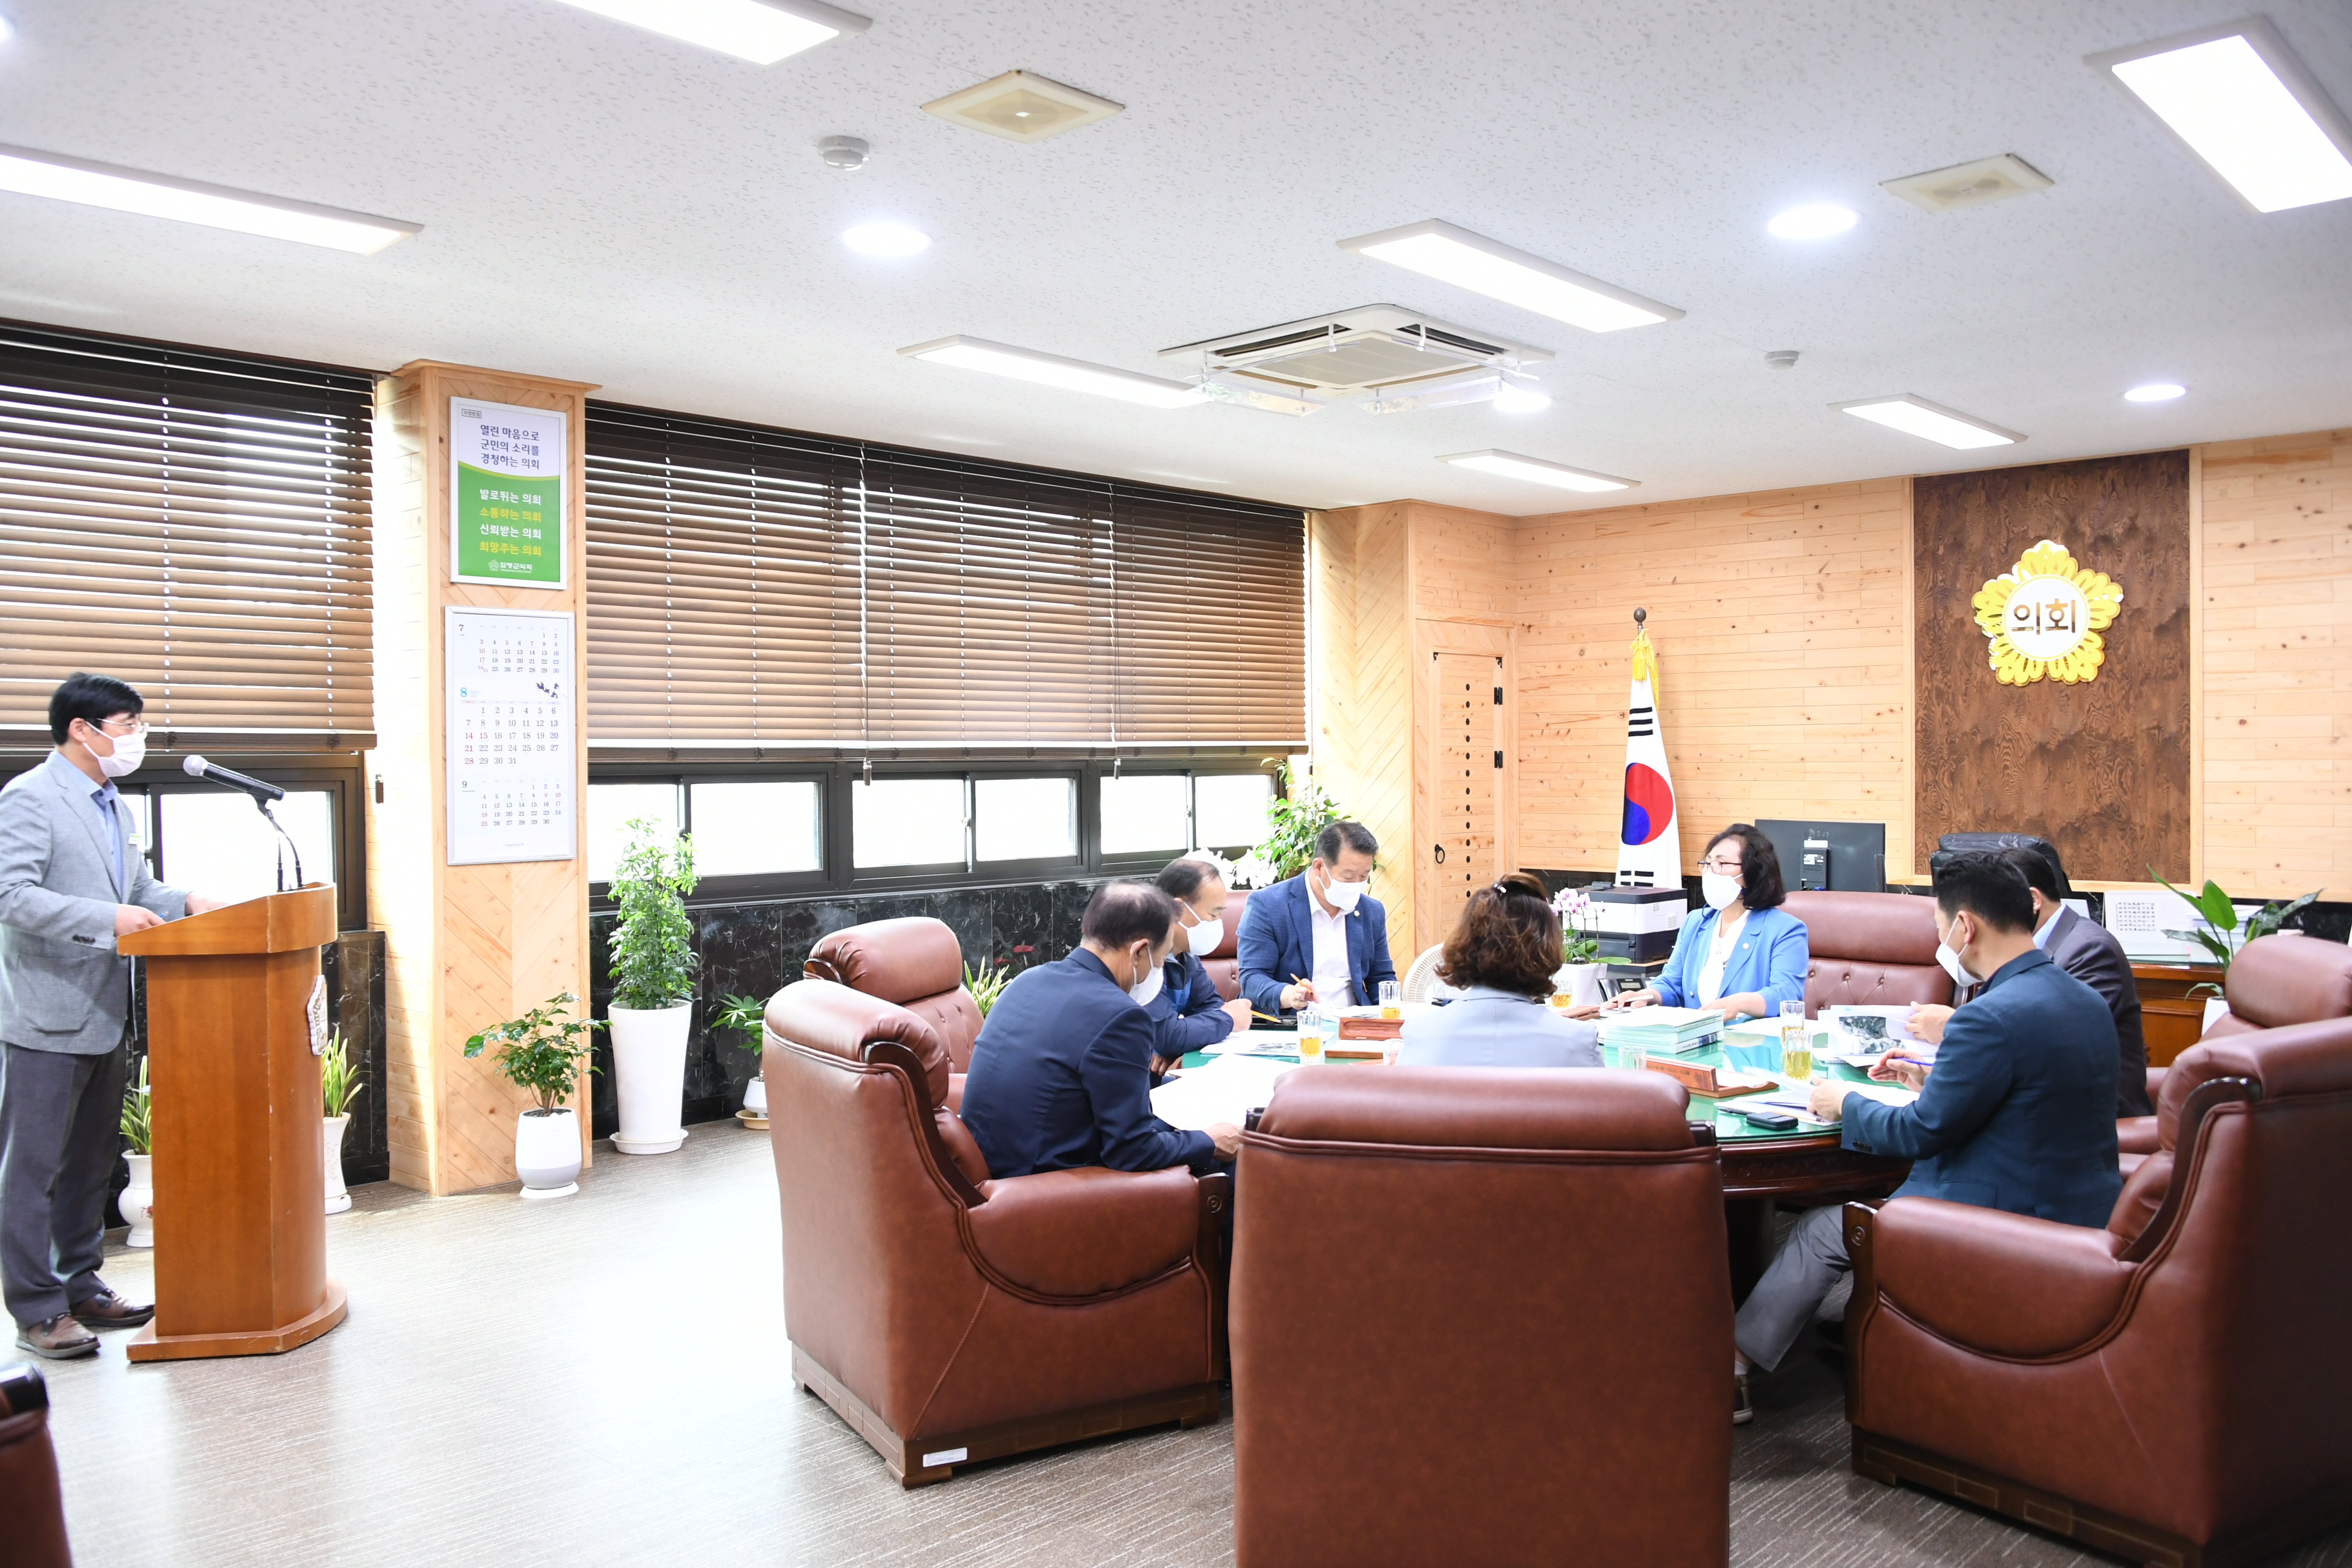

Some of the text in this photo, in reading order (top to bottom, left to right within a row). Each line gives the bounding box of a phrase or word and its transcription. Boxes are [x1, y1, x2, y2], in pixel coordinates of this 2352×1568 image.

[480, 425, 539, 441] 열린 마음으로
[480, 438, 539, 456] 군민의 소리를
[481, 453, 539, 470] 경청하는 의회
[480, 489, 541, 505] 발로뛰는 의회
[479, 507, 541, 522] 소통하는 의회
[480, 524, 541, 539] 신뢰받는 의회
[479, 541, 541, 556] 희망주는 의회
[2011, 598, 2076, 635] 의회
[460, 688, 467, 697] 8
